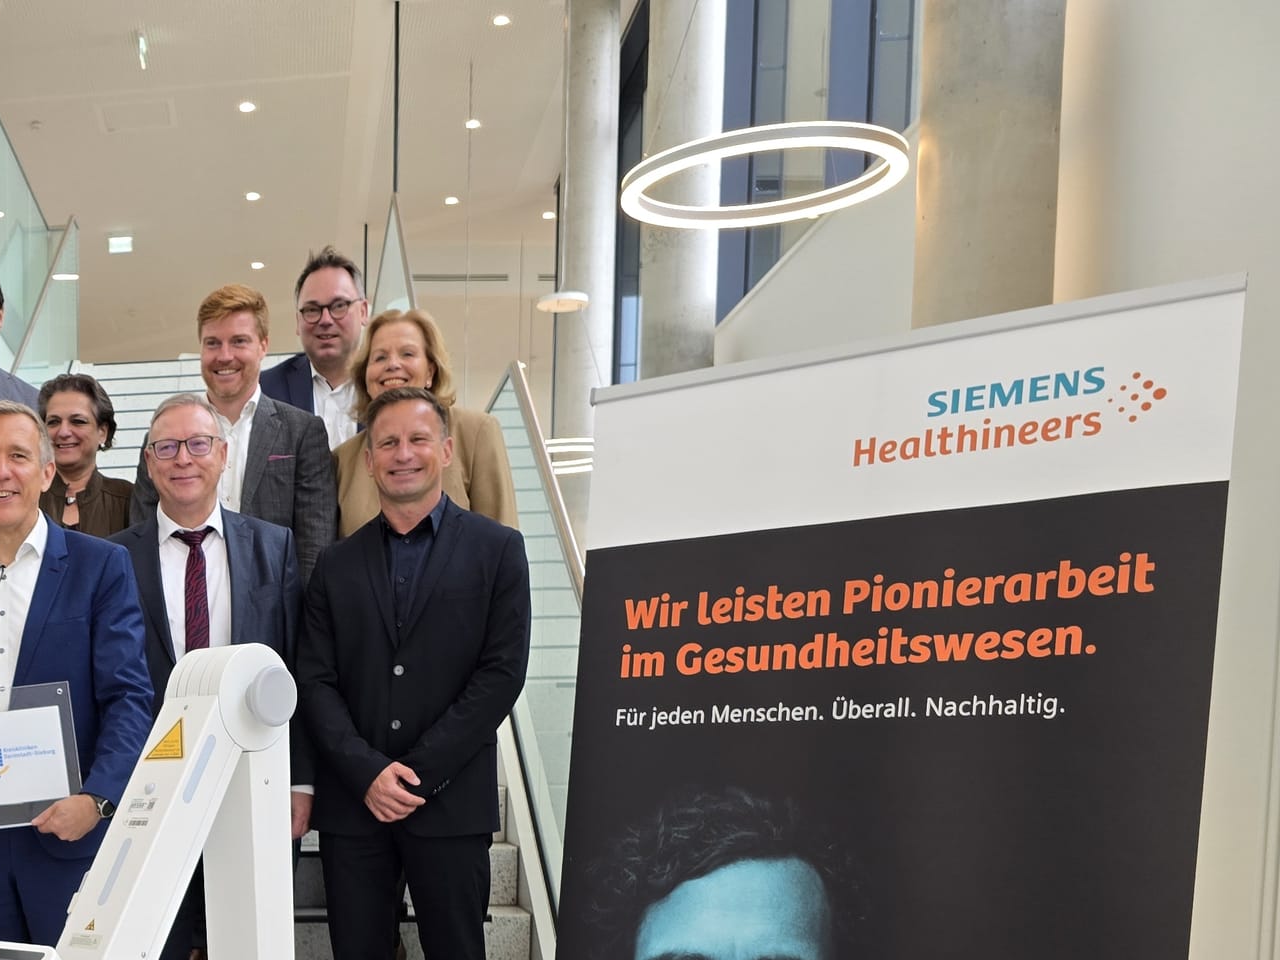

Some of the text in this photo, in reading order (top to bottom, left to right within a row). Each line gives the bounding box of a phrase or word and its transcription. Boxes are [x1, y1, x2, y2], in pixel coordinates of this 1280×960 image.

[927, 366, 1106, 417] SIEMENS
[853, 411, 1102, 467] Healthineers
[624, 552, 1156, 630] Wir leisten Pionierarbeit
[620, 625, 1097, 678] im Gesundheitswesen.
[615, 692, 1066, 730] Für jeden Menschen. Überall. Nachhaltig.
